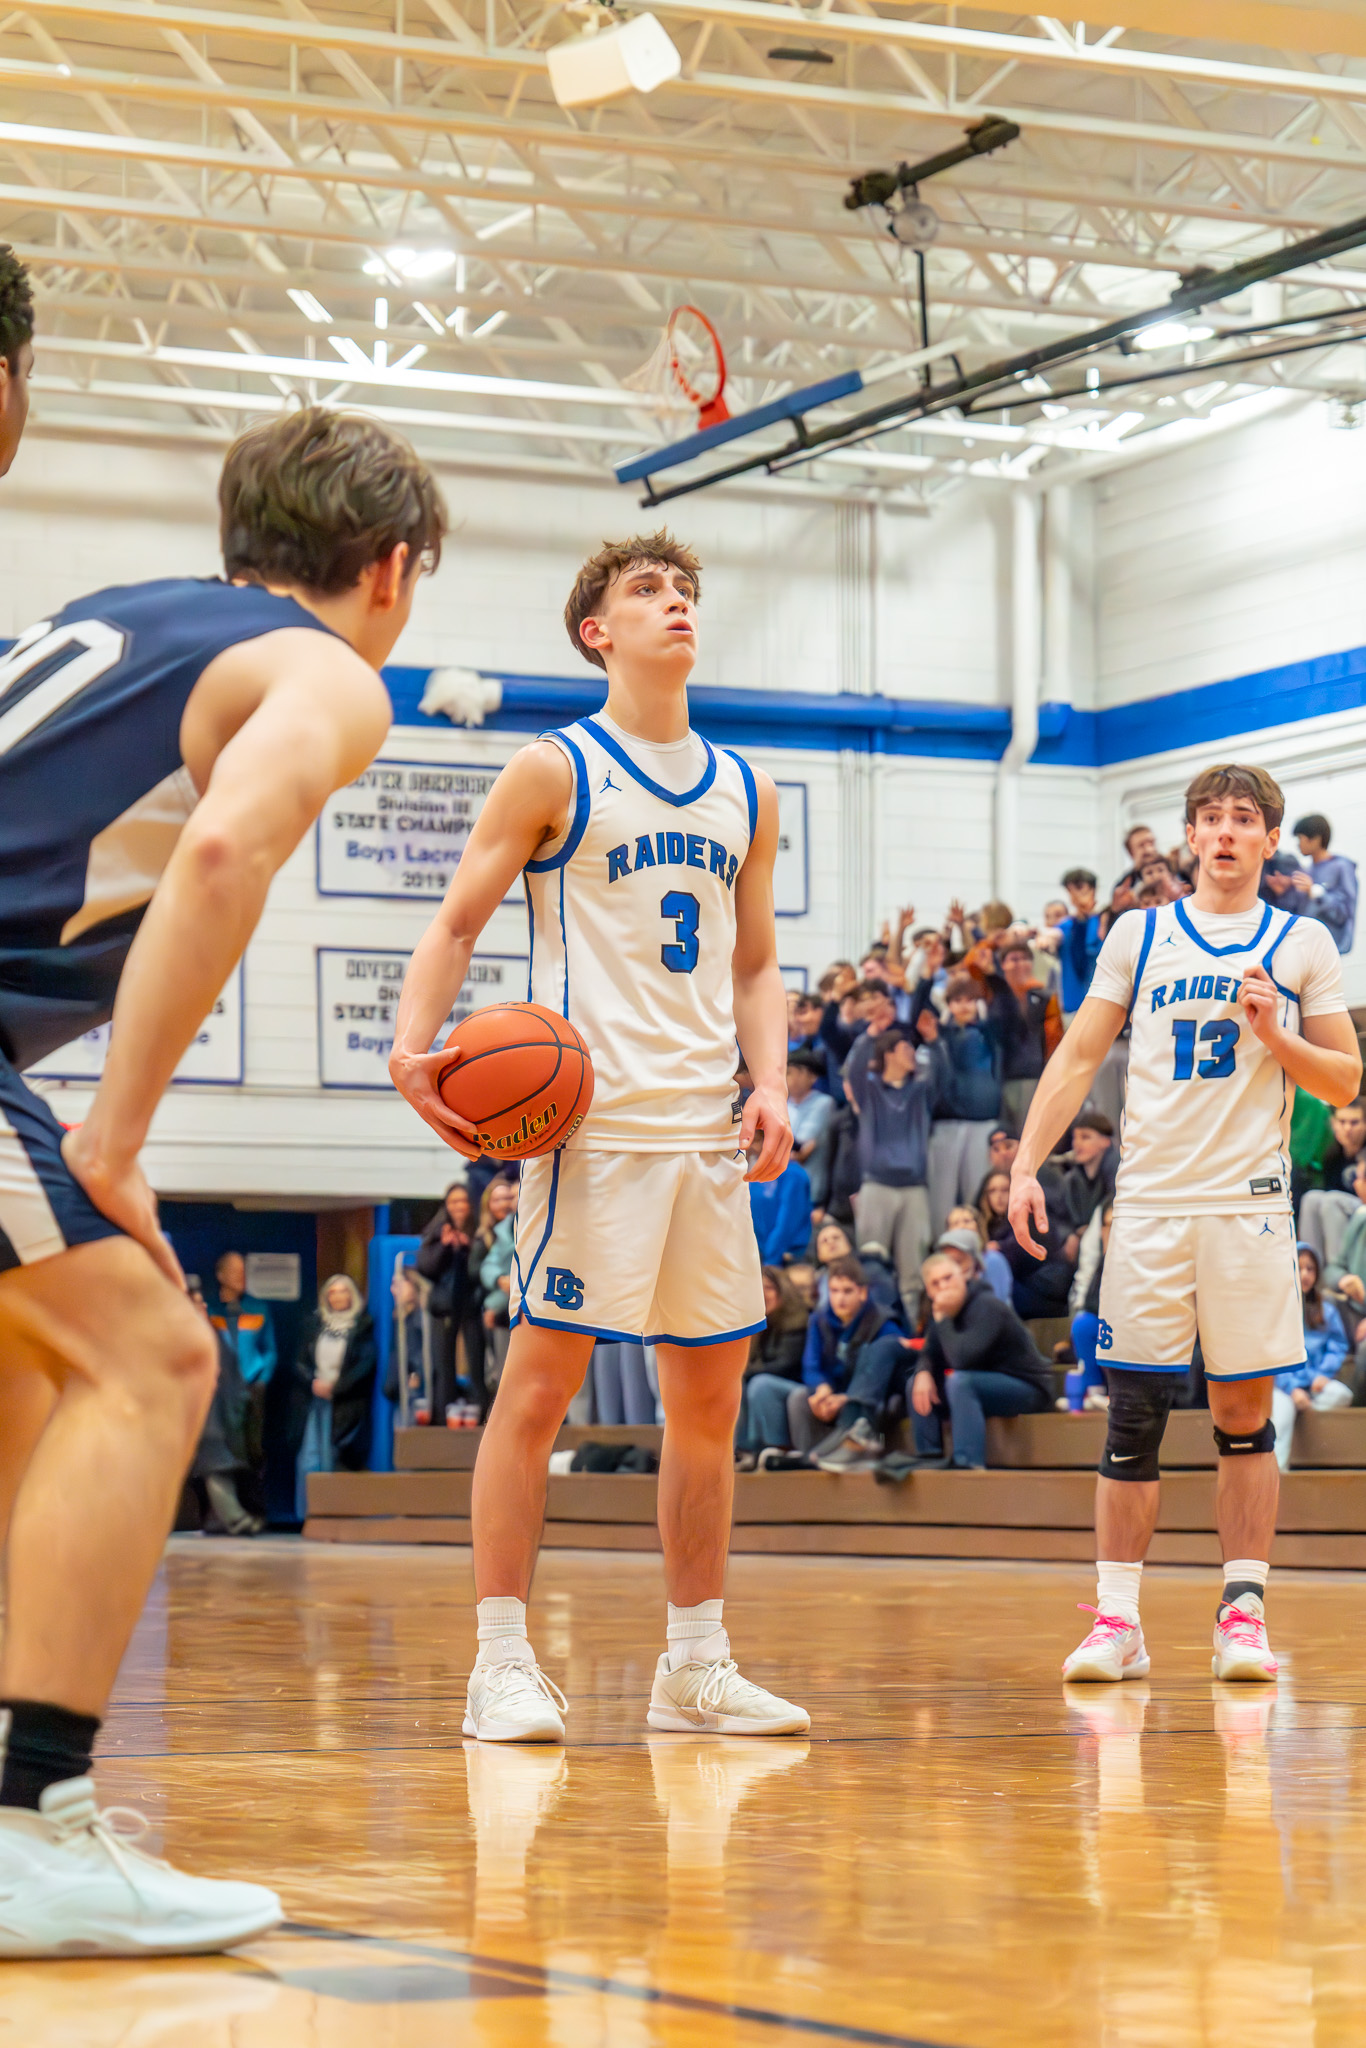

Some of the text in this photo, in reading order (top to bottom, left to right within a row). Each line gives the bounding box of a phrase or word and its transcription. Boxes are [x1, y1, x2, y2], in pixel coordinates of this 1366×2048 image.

[334, 813, 388, 829] STATE
[346, 841, 462, 863] Boys Lacro
[606, 832, 739, 891] RAIDERS
[660, 890, 701, 974] 3
[334, 1004, 390, 1021] STATE
[1171, 1018, 1240, 1080] 13
[473, 1101, 558, 1151] Baden
[543, 1266, 584, 1311] DS
